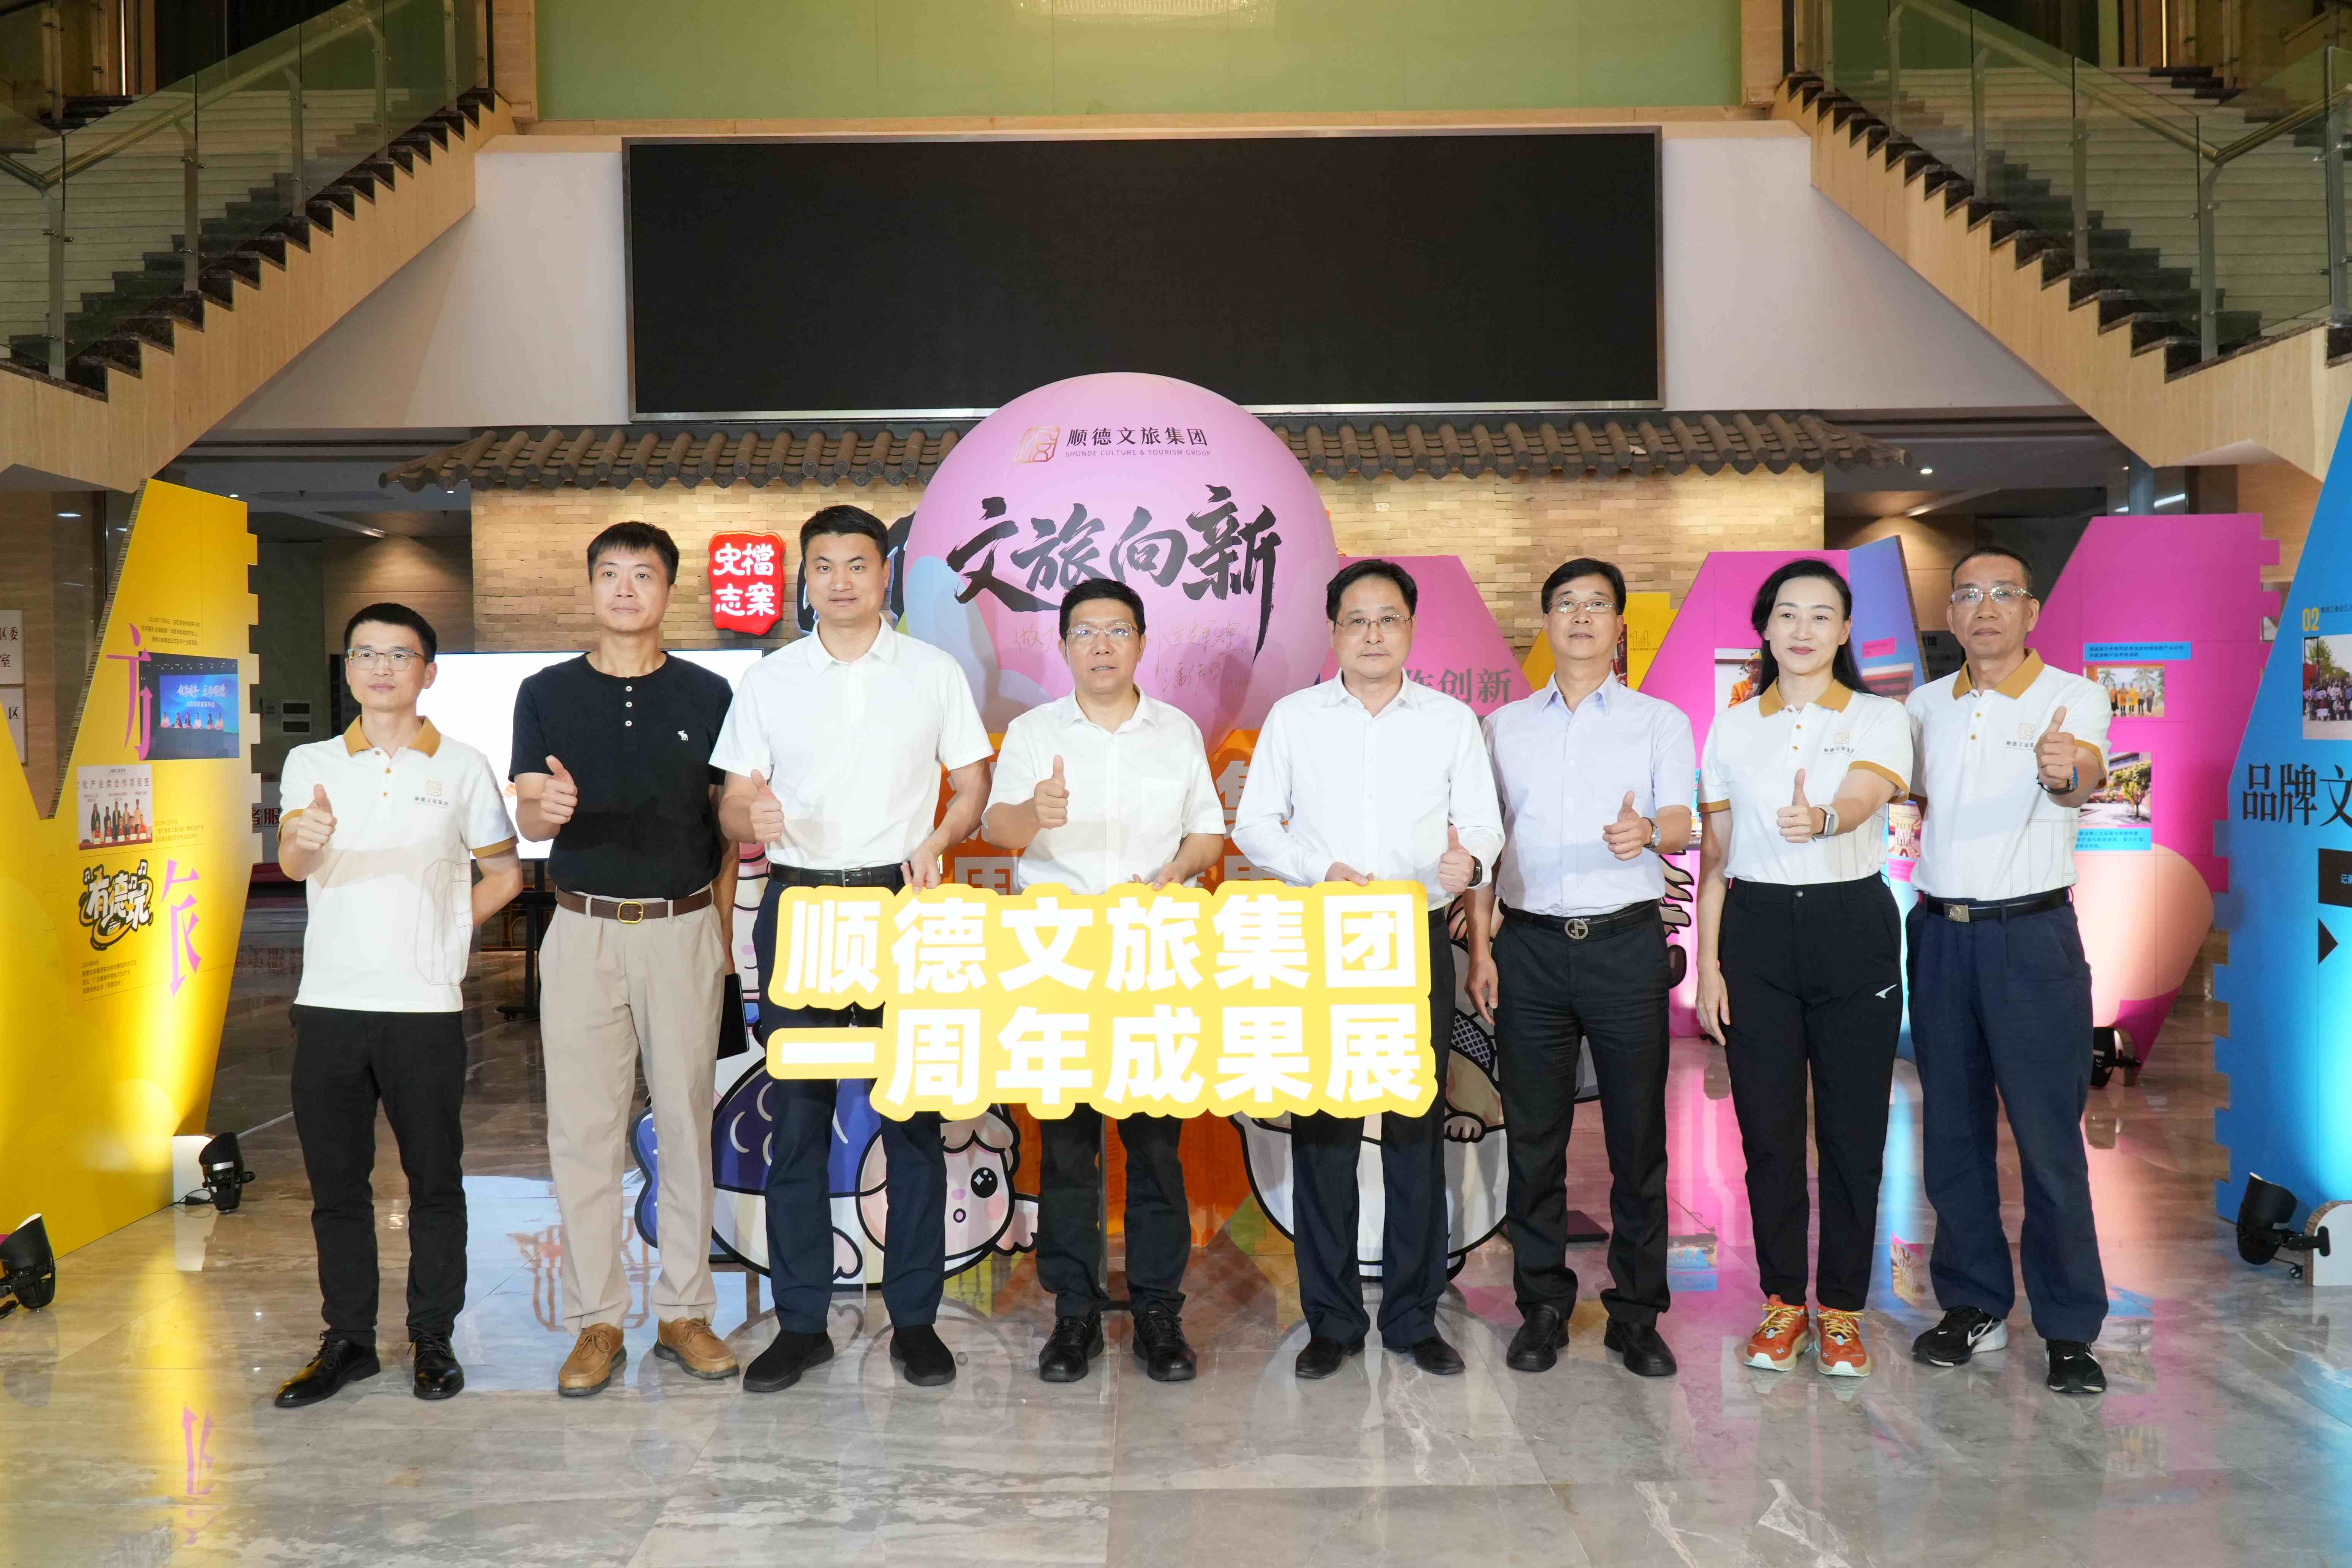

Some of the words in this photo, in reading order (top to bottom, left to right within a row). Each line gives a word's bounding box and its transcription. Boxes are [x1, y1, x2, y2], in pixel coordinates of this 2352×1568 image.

[1066, 427, 1208, 446] 顺德文旅集团
[947, 484, 1281, 669] 文旅向新
[2302, 607, 2319, 631] 02
[1628, 630, 1650, 646] 14
[9, 707, 19, 719] 区
[784, 894, 1416, 993] 顺德文旅集团
[780, 1002, 1422, 1105] 一周年成果展
